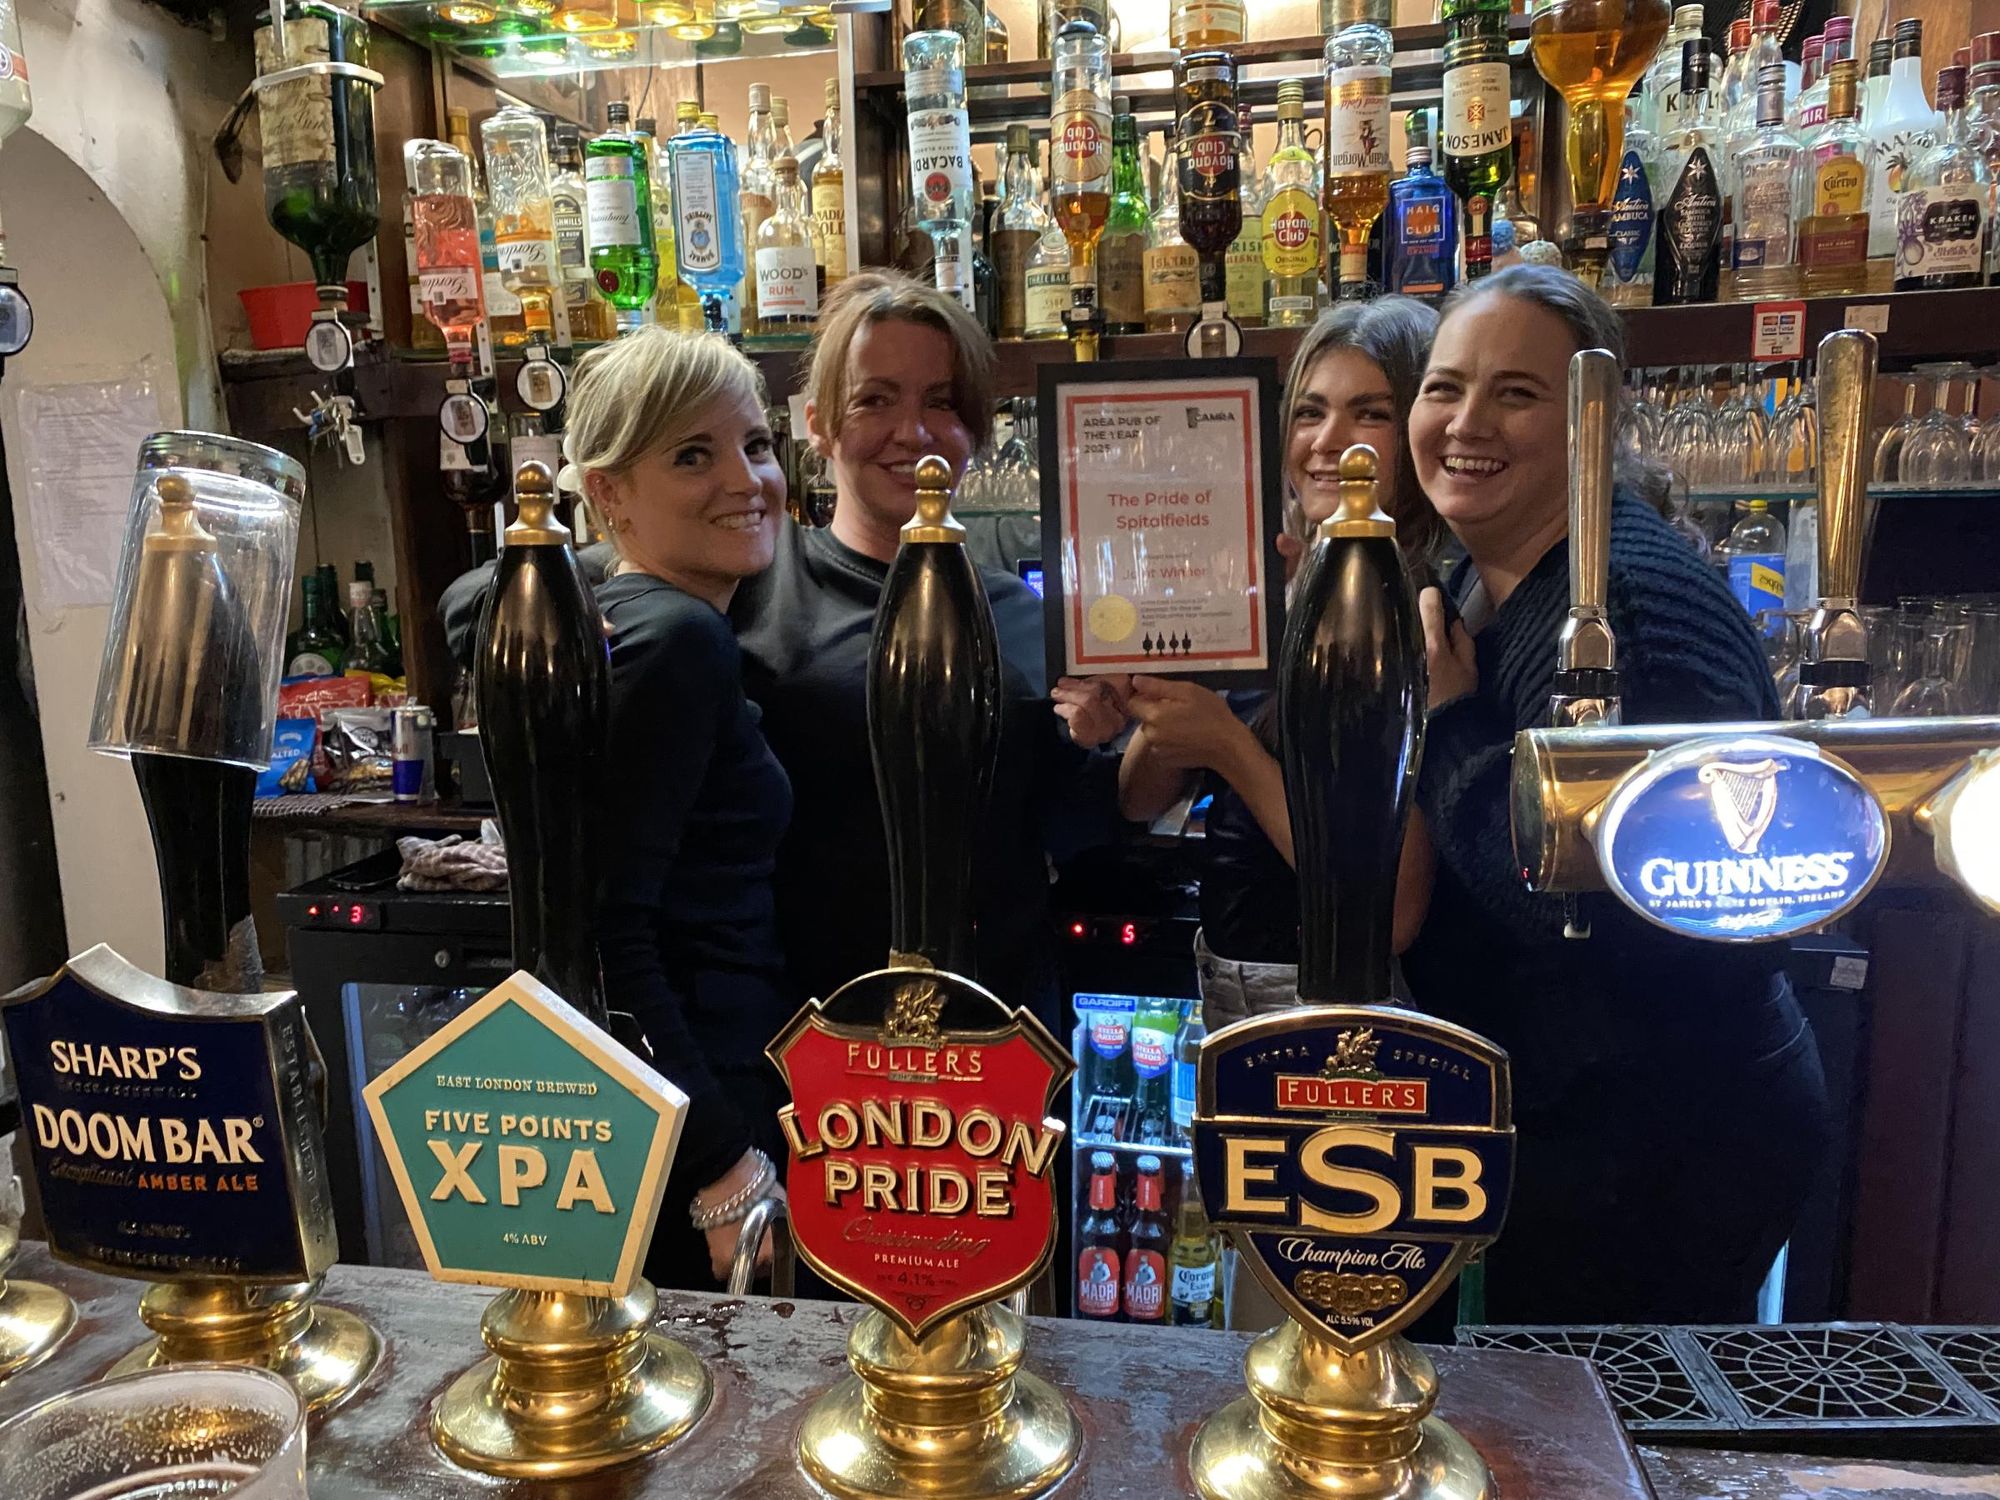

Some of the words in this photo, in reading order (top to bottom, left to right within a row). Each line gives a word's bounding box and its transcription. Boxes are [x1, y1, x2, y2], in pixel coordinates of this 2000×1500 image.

[1067, 126, 1094, 140] Club
[1446, 127, 1508, 149] JAMESON
[1060, 141, 1103, 154] Havana
[1197, 142, 1226, 155] Club
[1187, 156, 1234, 170] Havana
[1333, 153, 1367, 168] Morgan
[1406, 204, 1440, 215] HAIG
[1611, 211, 1648, 222] AMBUCA
[1272, 218, 1312, 230] Havana
[1930, 215, 1975, 224] KRAKEN
[1278, 230, 1305, 242] Club
[1406, 225, 1441, 235] CLUB
[768, 285, 795, 296] RUM
[1083, 417, 1115, 428] AREA
[1118, 416, 1141, 426] PUB
[1145, 415, 1161, 425] OF
[1195, 412, 1235, 423] CAMRA
[1084, 430, 1106, 440] THE
[1083, 444, 1111, 454] 2025
[1107, 494, 1139, 507] The
[1145, 492, 1190, 506] Pride
[1195, 489, 1212, 504] of
[1116, 513, 1210, 531] Spitalfields
[270, 749, 301, 760] ALTED
[1639, 850, 1856, 899] GUINNESS
[1799, 889, 1846, 904] IRELAND
[350, 904, 363, 924] 3
[1122, 923, 1136, 944] 5
[1098, 1027, 1124, 1035] STELLA
[50, 1040, 202, 1081] SHARP'S
[848, 1043, 984, 1075] FULLER'S
[1244, 1045, 1310, 1069] EXTRA
[1392, 1048, 1472, 1081] SPECIAL
[436, 1075, 472, 1088] EAST
[475, 1077, 533, 1092] LONDON
[536, 1080, 598, 1096] BREWED
[1287, 1080, 1416, 1108] FULLER'S
[32, 1103, 157, 1163] DOOM
[424, 1109, 490, 1134] FIVE
[500, 1114, 613, 1142] POINTS
[777, 1094, 1067, 1177] LONDON
[138, 1172, 208, 1192] AMBER
[216, 1173, 259, 1192] ALE
[426, 1139, 616, 1214] XPA
[1225, 1125, 1488, 1234] ESB
[823, 1157, 1012, 1217] PRIDE
[503, 1233, 519, 1244] 4%
[521, 1234, 547, 1246] ABV
[874, 1253, 934, 1267] PREMIUM
[937, 1258, 960, 1268] ALE
[1278, 1237, 1379, 1274] Champion
[1381, 1243, 1426, 1271] Ale
[897, 1271, 936, 1287] 4.1%
[1326, 1314, 1340, 1324] ALC
[1341, 1314, 1360, 1326] 5.5%
[1361, 1315, 1376, 1327] VOL
